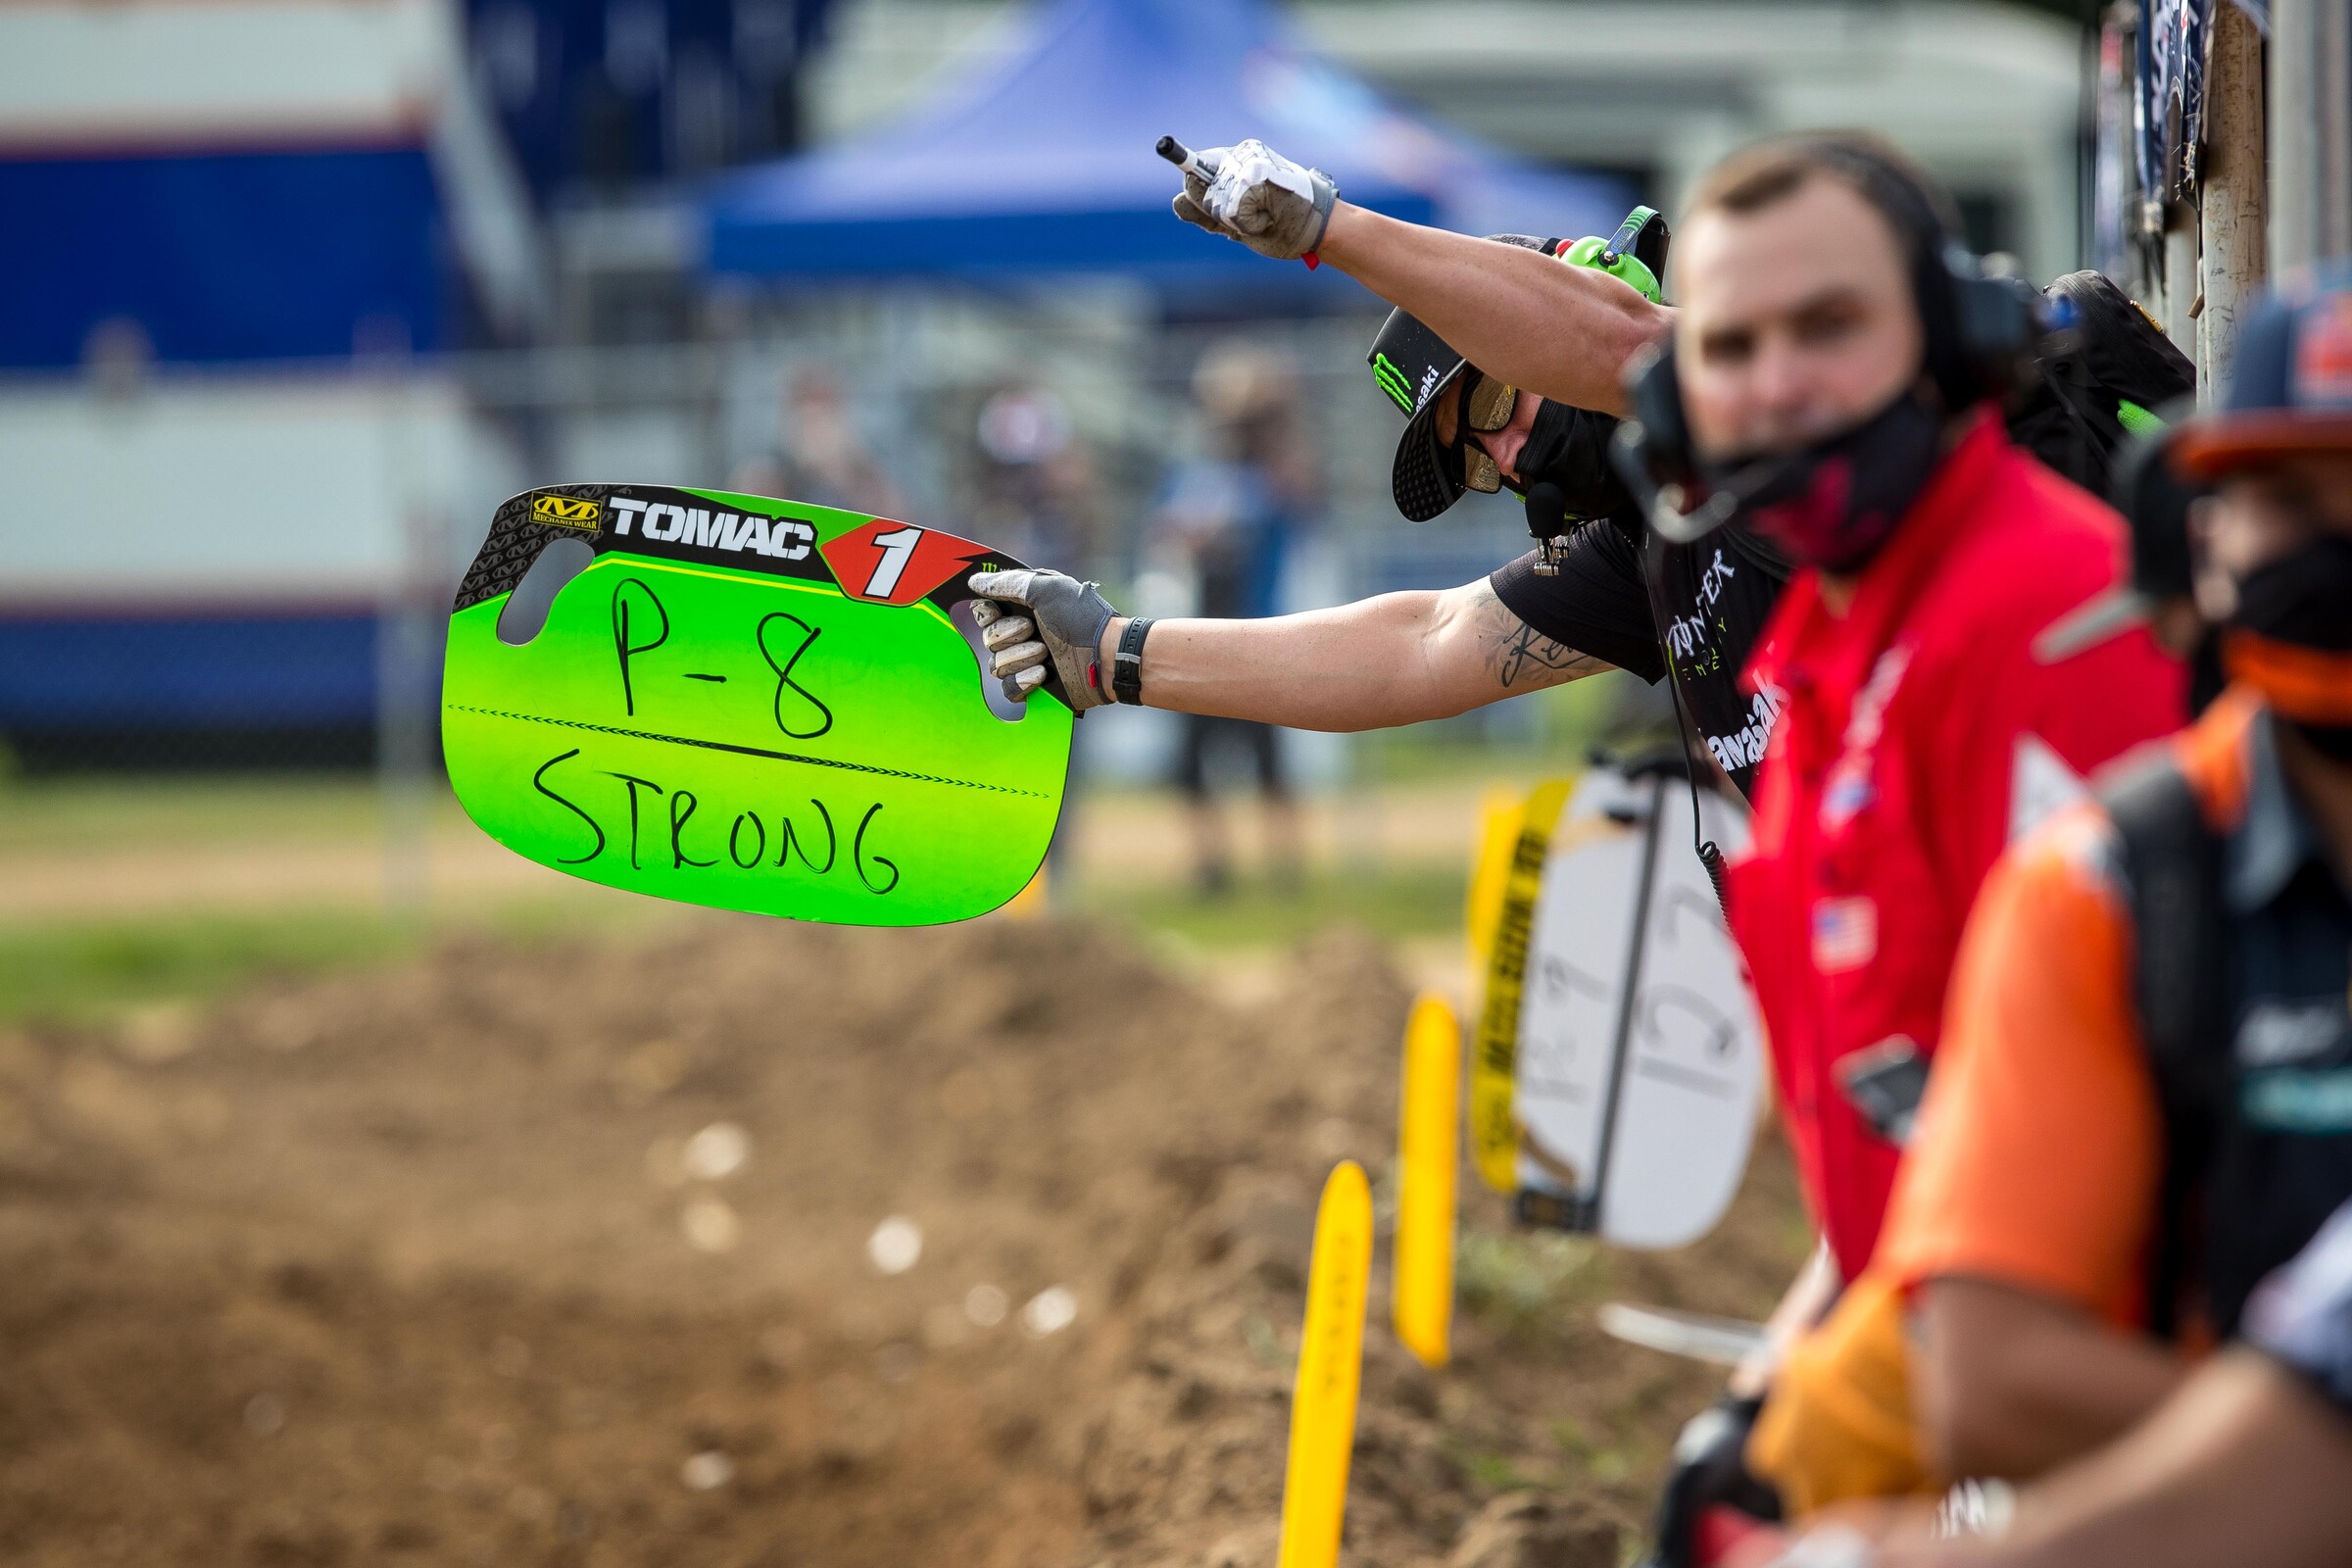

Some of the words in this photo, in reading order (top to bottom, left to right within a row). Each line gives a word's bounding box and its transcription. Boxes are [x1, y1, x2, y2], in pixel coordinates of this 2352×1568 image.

[1415, 365, 1440, 413] asaki
[532, 512, 573, 526] MECHANIX
[573, 520, 597, 530] WEAR
[609, 497, 816, 561] TOMAC
[864, 526, 925, 598] 1
[612, 578, 833, 739] P-8
[534, 748, 900, 894] STRONG
